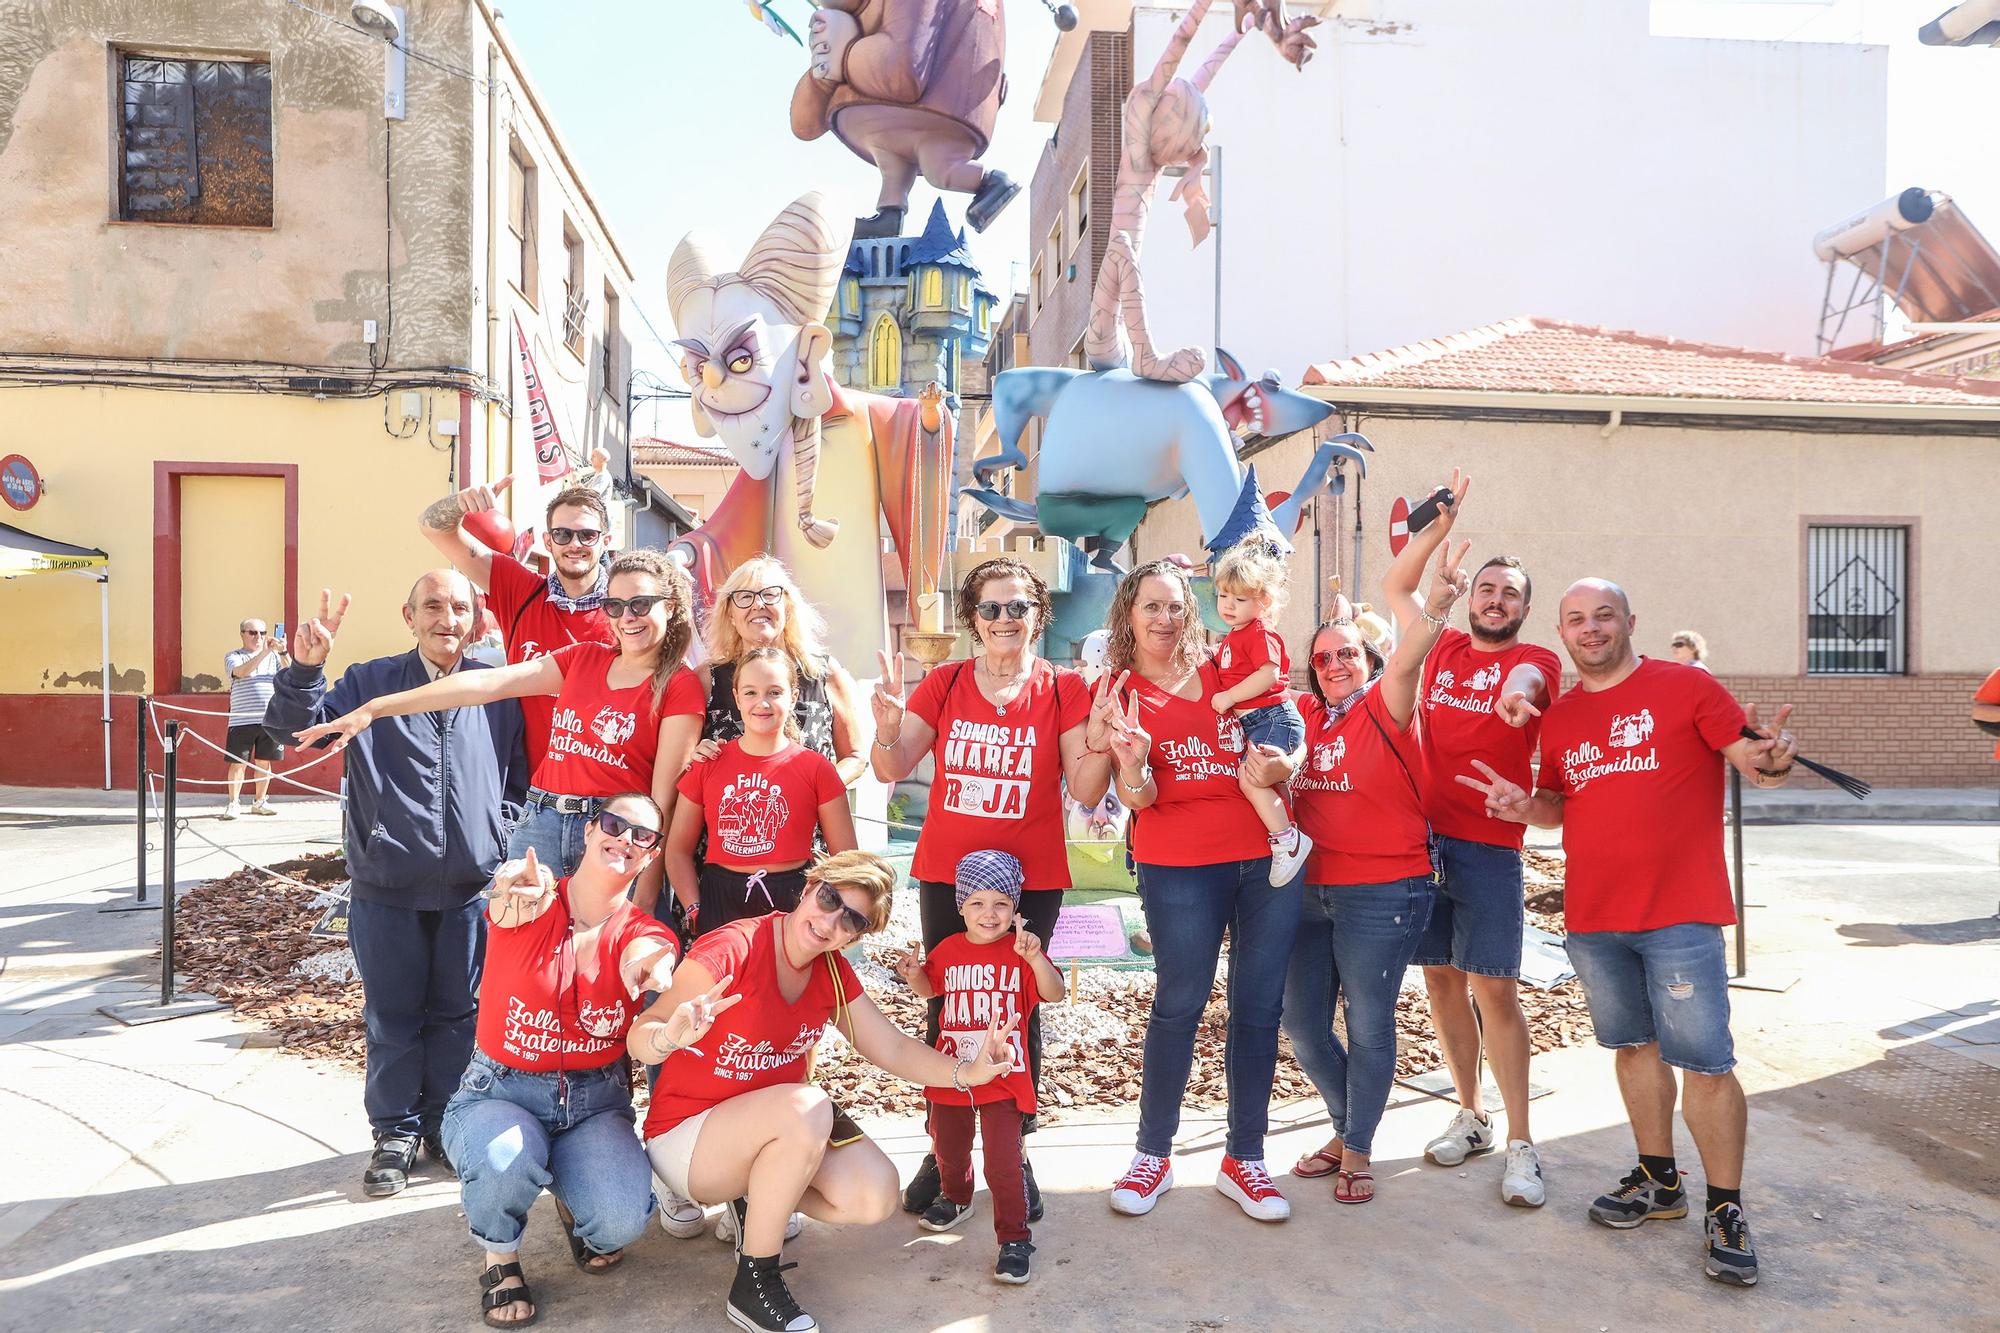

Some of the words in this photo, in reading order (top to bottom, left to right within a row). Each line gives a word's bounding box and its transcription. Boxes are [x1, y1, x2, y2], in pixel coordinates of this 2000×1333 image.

[950, 719, 1011, 746] SOMOS
[1014, 726, 1037, 746] LA
[944, 739, 1033, 778] MAREA
[1159, 736, 1215, 760] Falla
[1561, 741, 1604, 769] Falla
[1175, 773, 1192, 781] SINCE
[1565, 748, 1660, 785] Fraternidad
[737, 773, 769, 790] Falla
[724, 841, 773, 855] FRATERNIDAD
[742, 835, 758, 844] ELDA
[944, 964, 995, 992] SOMOS
[999, 965, 1020, 992] LA
[508, 996, 565, 1032] Falla
[503, 1040, 521, 1056] SINCE
[522, 1050, 540, 1062] 1957
[713, 1066, 734, 1080] SINCE
[735, 1072, 754, 1082] 1957
